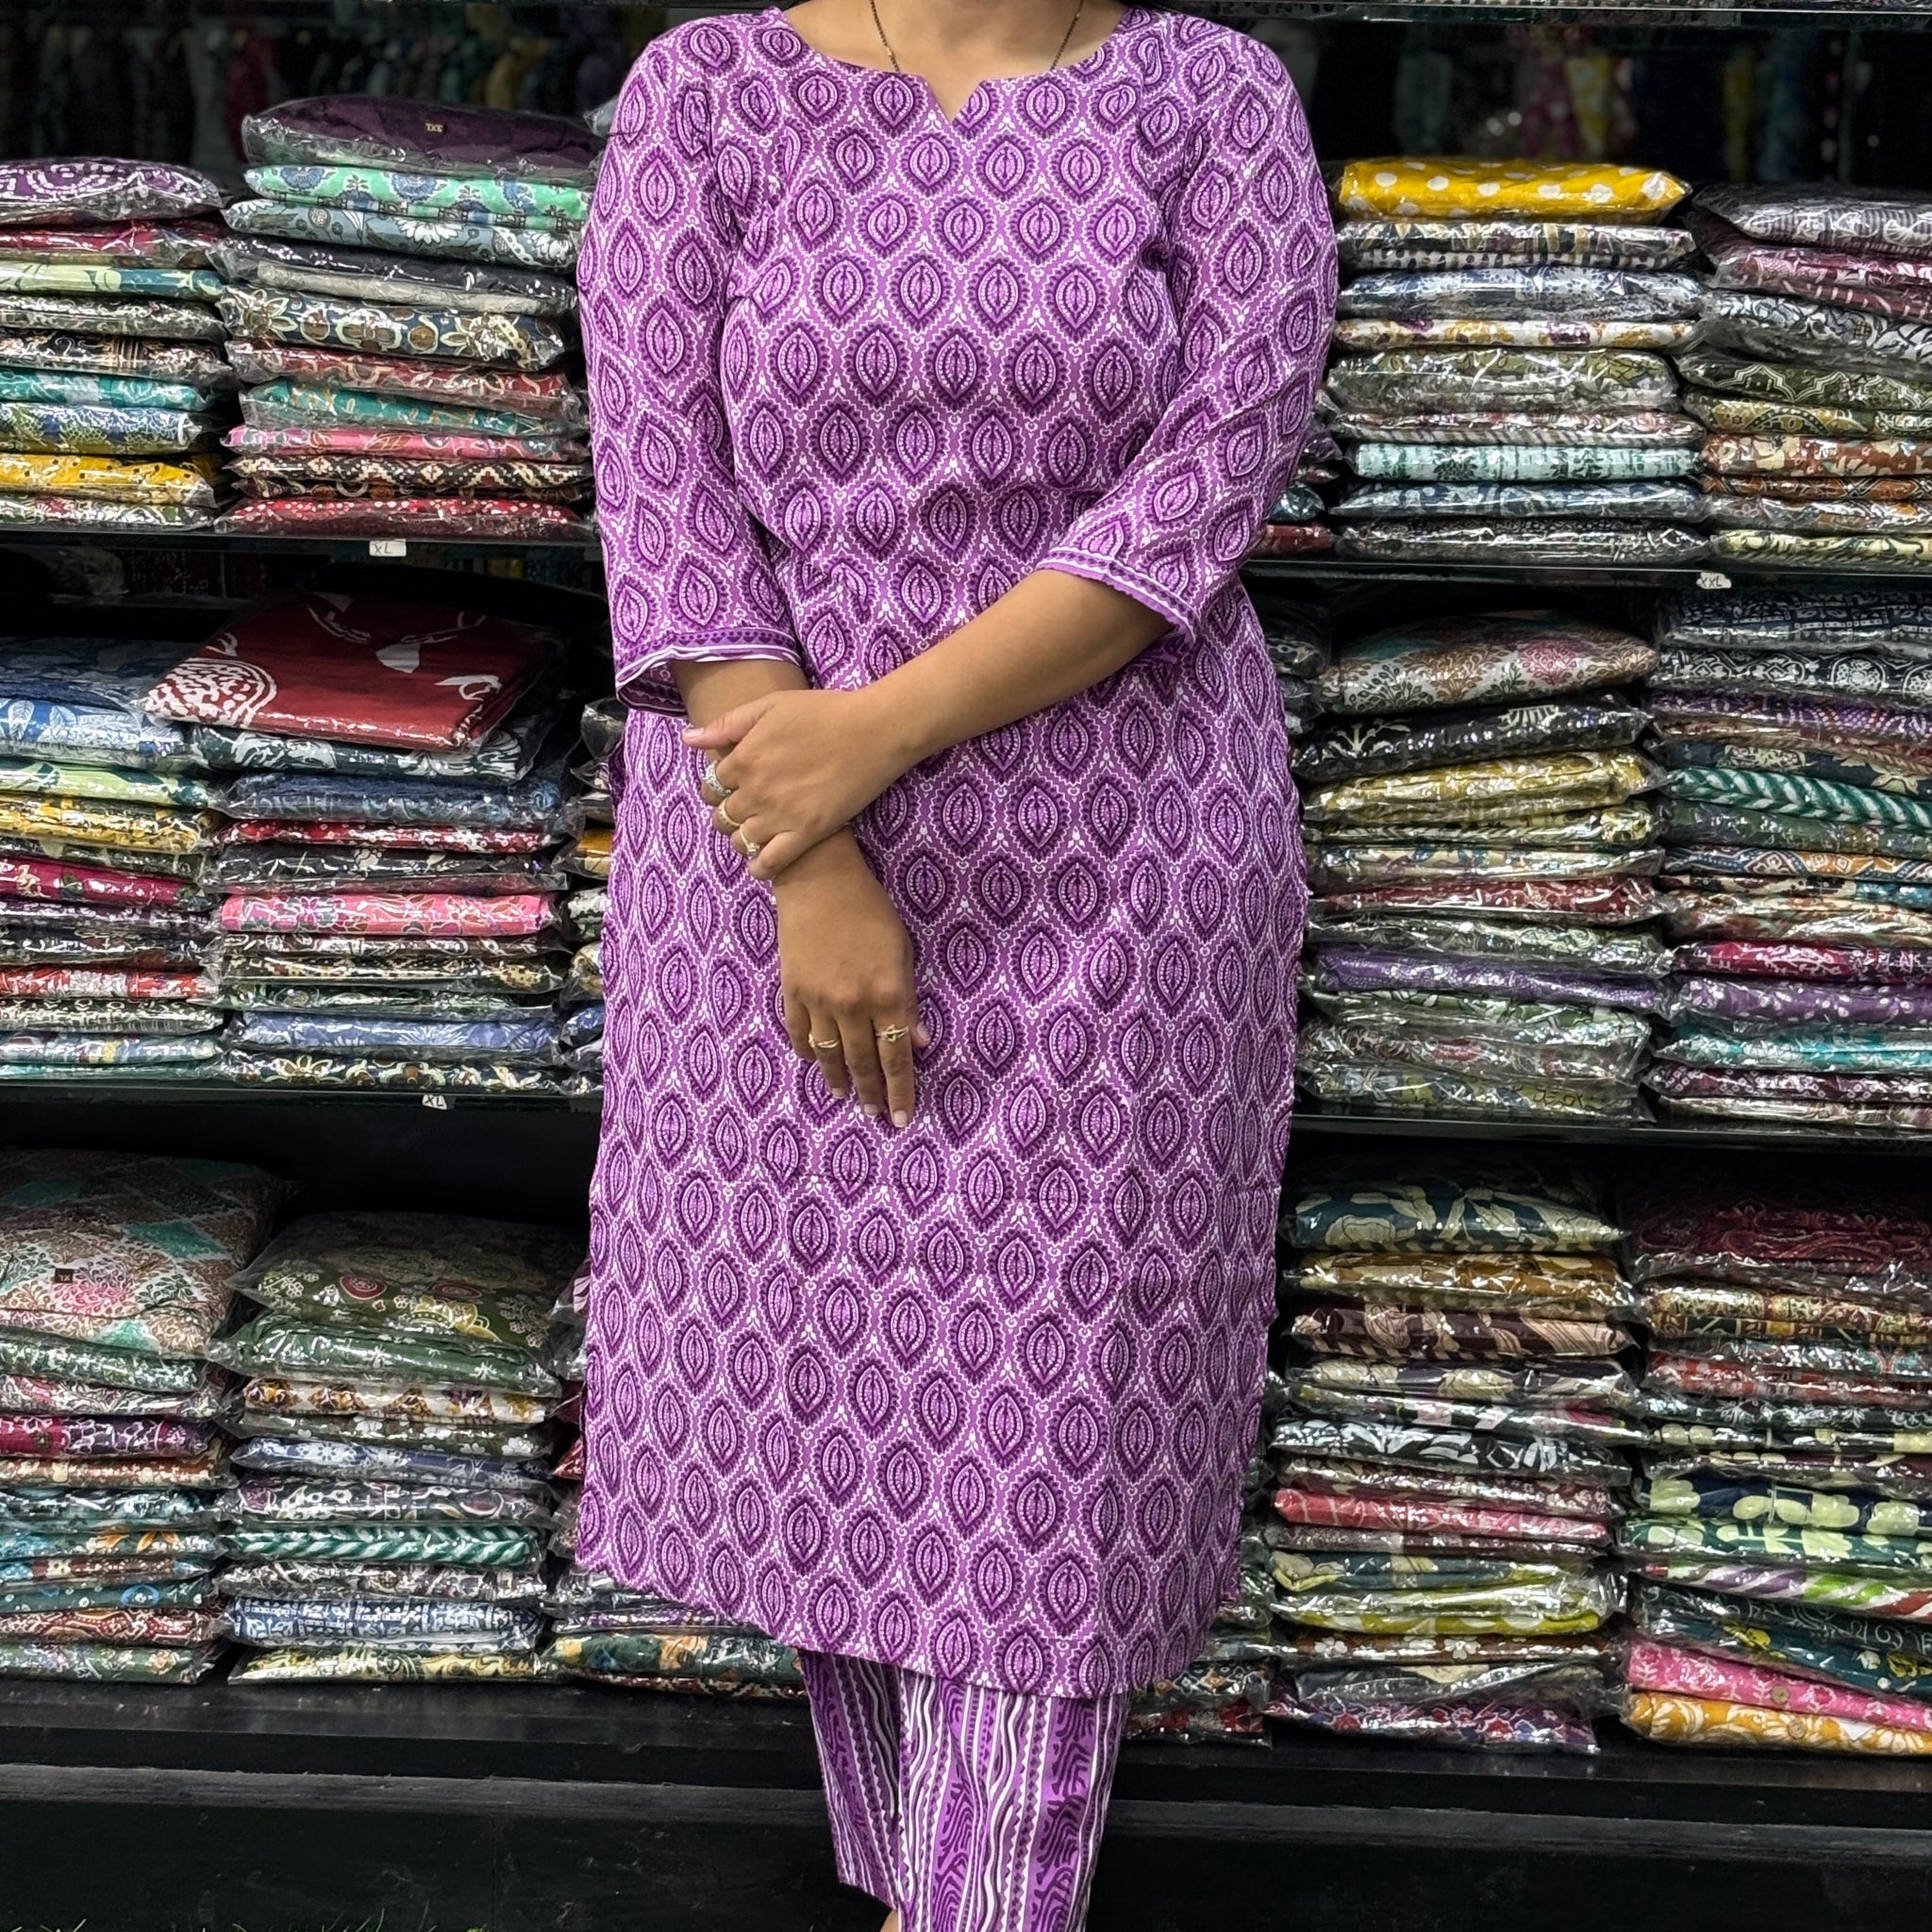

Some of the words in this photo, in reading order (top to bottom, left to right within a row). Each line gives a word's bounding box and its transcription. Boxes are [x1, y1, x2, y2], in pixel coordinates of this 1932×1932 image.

[374, 541, 392, 555] XL
[425, 1095, 444, 1107] XL
[58, 1274, 72, 1282] XL
